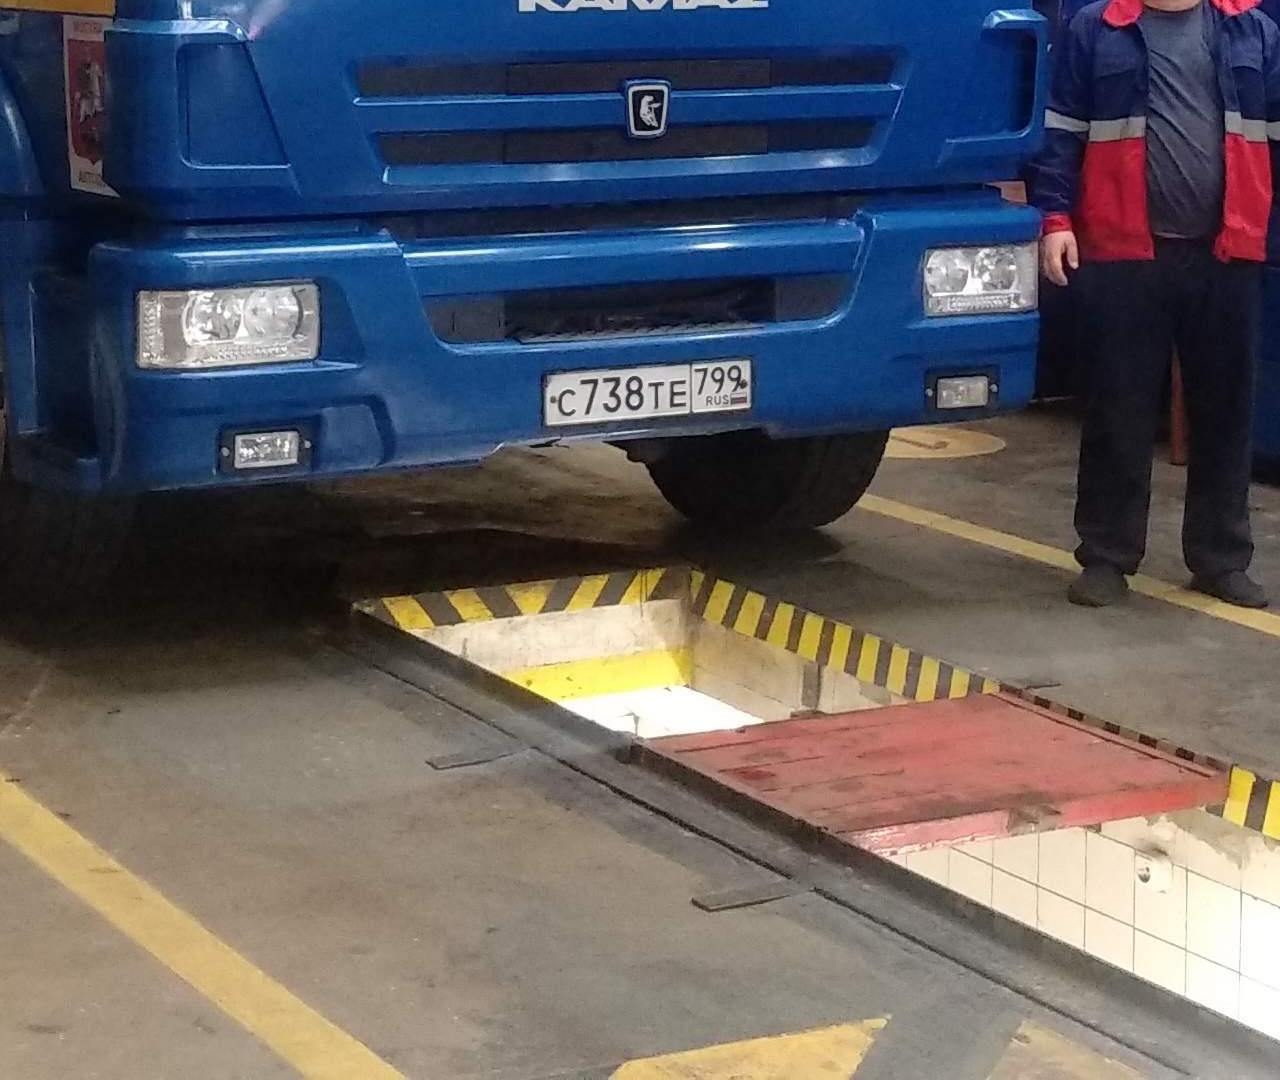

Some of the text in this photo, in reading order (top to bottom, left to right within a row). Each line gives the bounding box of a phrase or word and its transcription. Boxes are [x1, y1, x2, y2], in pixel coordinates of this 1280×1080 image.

[556, 365, 743, 417] С738ТЕ 799
[705, 393, 729, 406] RUS
